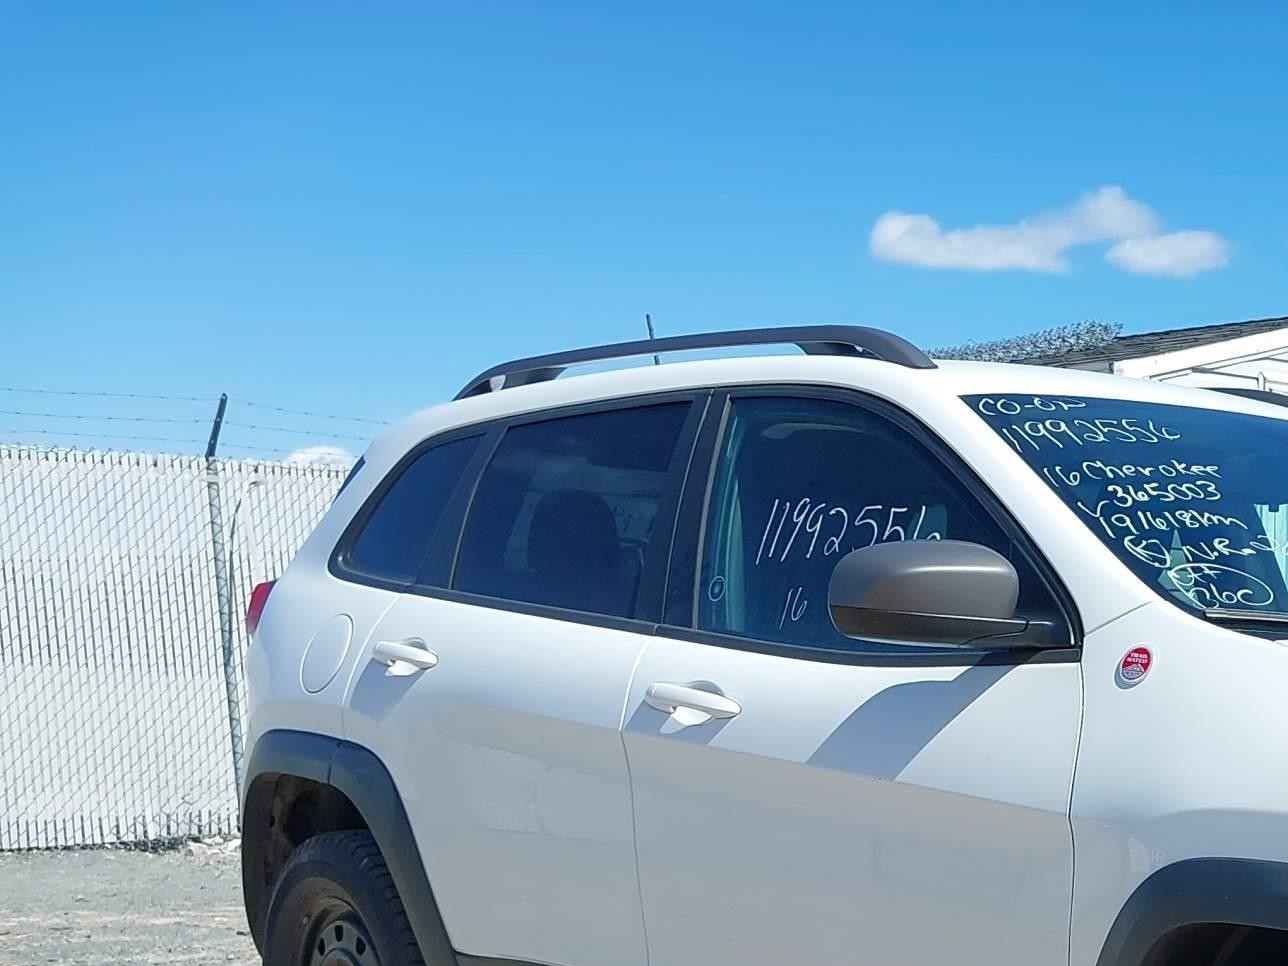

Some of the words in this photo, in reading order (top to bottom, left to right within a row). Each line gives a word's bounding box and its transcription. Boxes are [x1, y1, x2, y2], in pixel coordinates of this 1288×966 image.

[1002, 419, 1181, 453] 11992556
[1043, 465, 1080, 488] 16
[1107, 480, 1221, 508] 365003
[778, 587, 808, 631] 16
